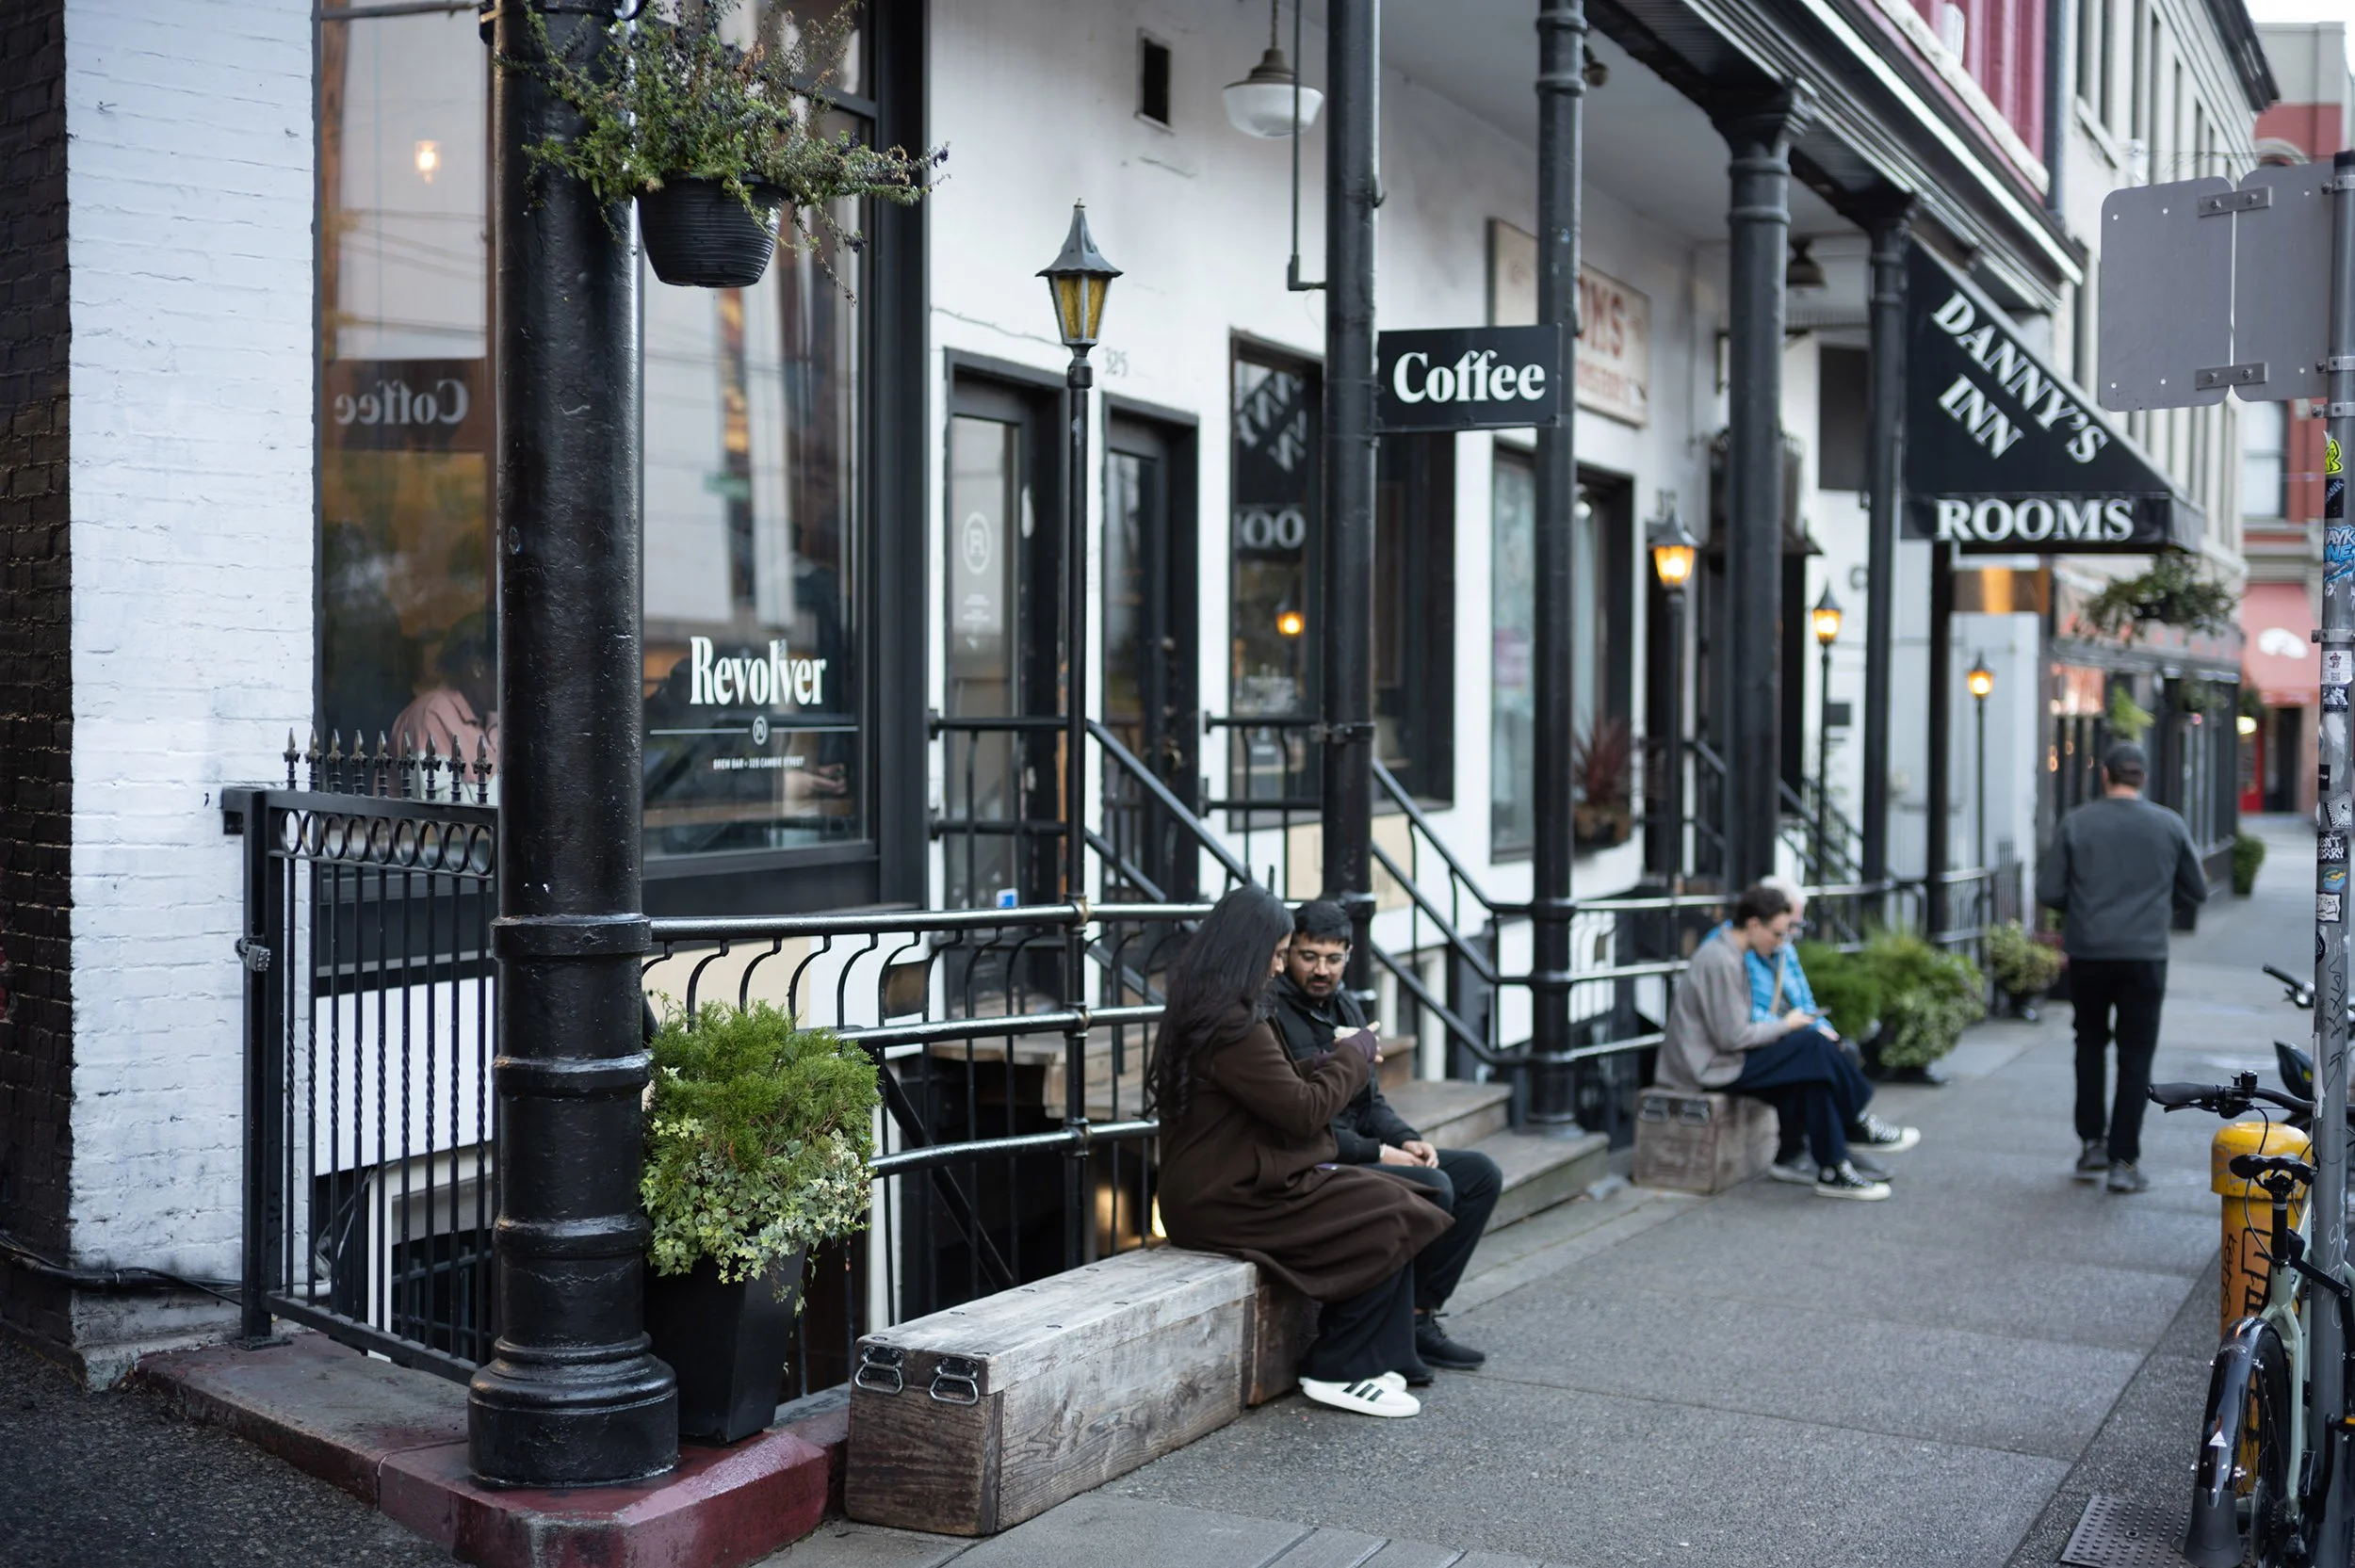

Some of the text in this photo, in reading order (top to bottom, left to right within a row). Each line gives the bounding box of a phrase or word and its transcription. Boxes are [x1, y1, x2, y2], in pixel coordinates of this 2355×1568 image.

[1392, 349, 1546, 403] Coffee
[1930, 290, 2109, 464] DANNY'S
[1937, 373, 2025, 461] INN
[1936, 498, 2135, 542] ROOMS
[690, 636, 827, 705] Revolver
